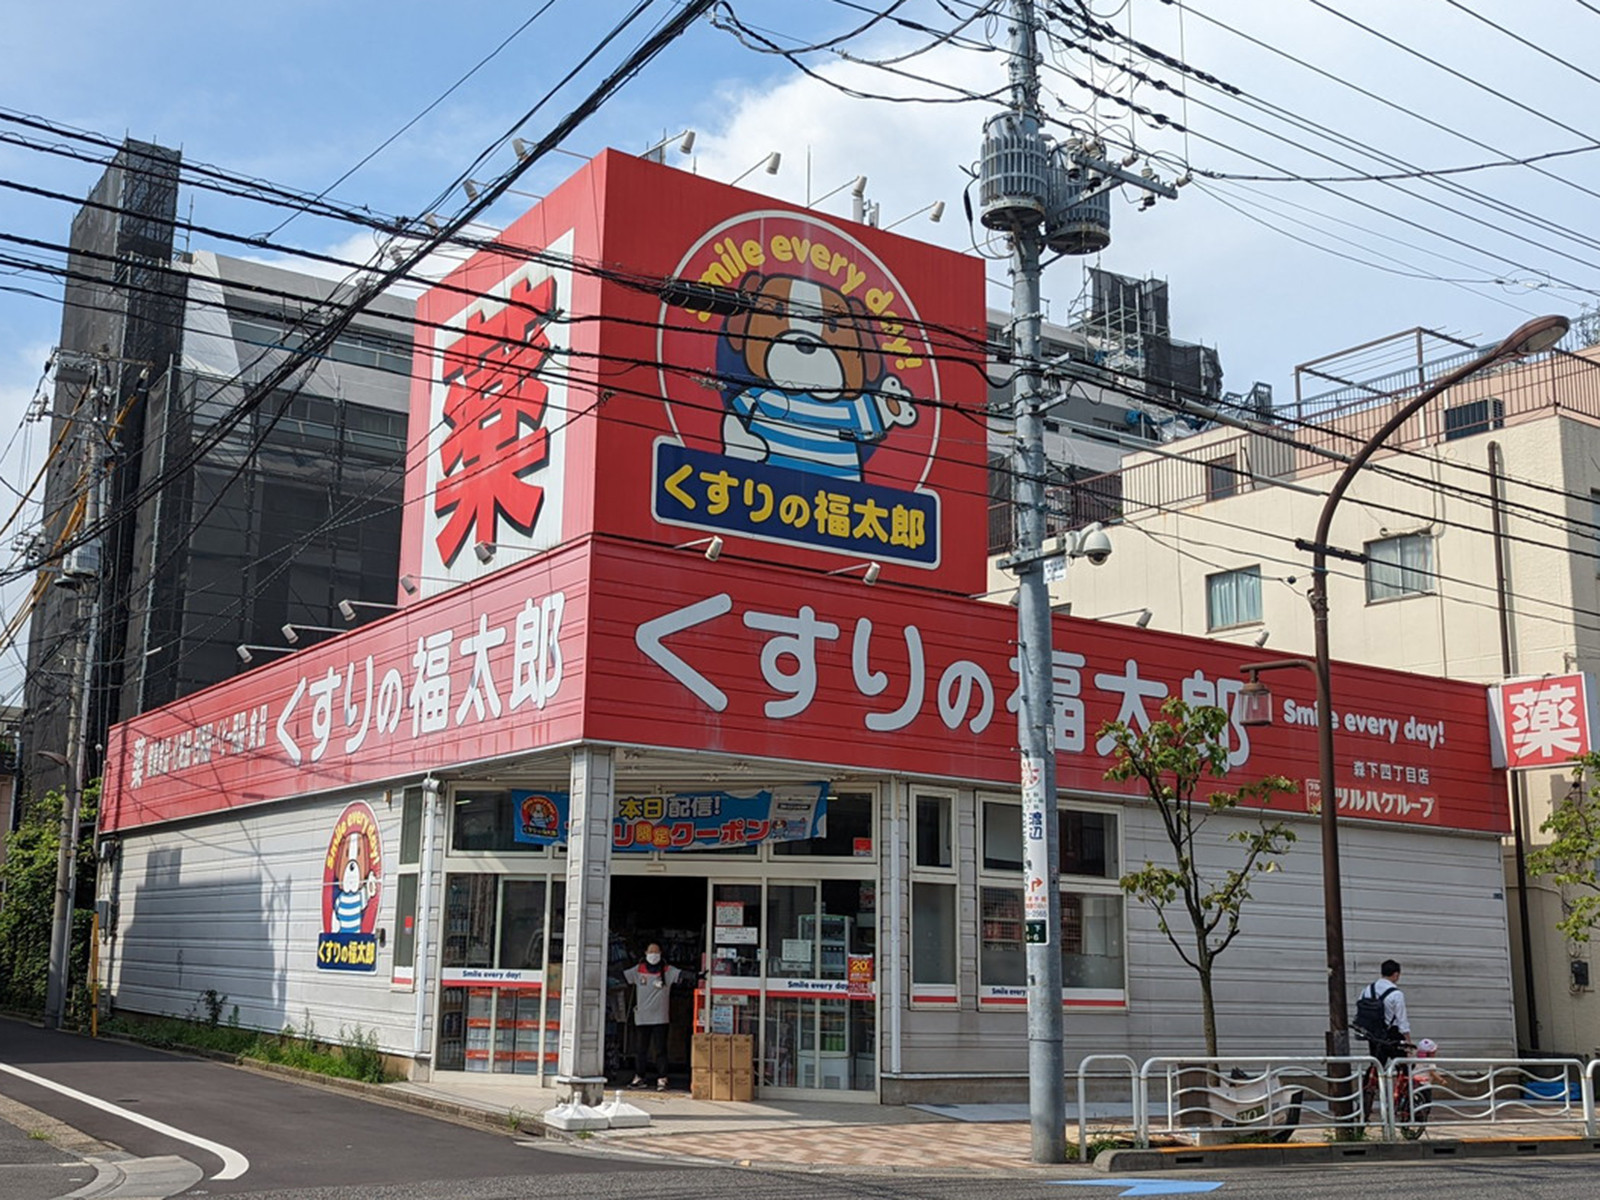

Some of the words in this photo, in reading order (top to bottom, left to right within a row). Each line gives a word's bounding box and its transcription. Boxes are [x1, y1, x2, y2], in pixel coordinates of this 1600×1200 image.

[685, 237, 765, 322] mile
[770, 235, 866, 295] every
[865, 288, 923, 370] day!
[434, 274, 558, 568] 薬
[664, 464, 925, 549] くすりの福太郎
[276, 591, 565, 766] くすりの福太郎
[1283, 698, 1339, 729] Smie
[1344, 712, 1398, 744] every
[1404, 716, 1445, 750] day!
[1509, 684, 1581, 759] 薬
[1353, 760, 1430, 786] 森下四丁目店
[1334, 786, 1435, 818] ツルハグループ
[614, 817, 771, 847] リ限定クーポン
[318, 940, 376, 965] くすりの福太郎
[462, 970, 482, 979] Smile
[483, 972, 504, 980] every
[505, 971, 522, 980] day!
[787, 981, 809, 989] Smile
[811, 983, 833, 991] every
[992, 987, 1008, 995] Smile
